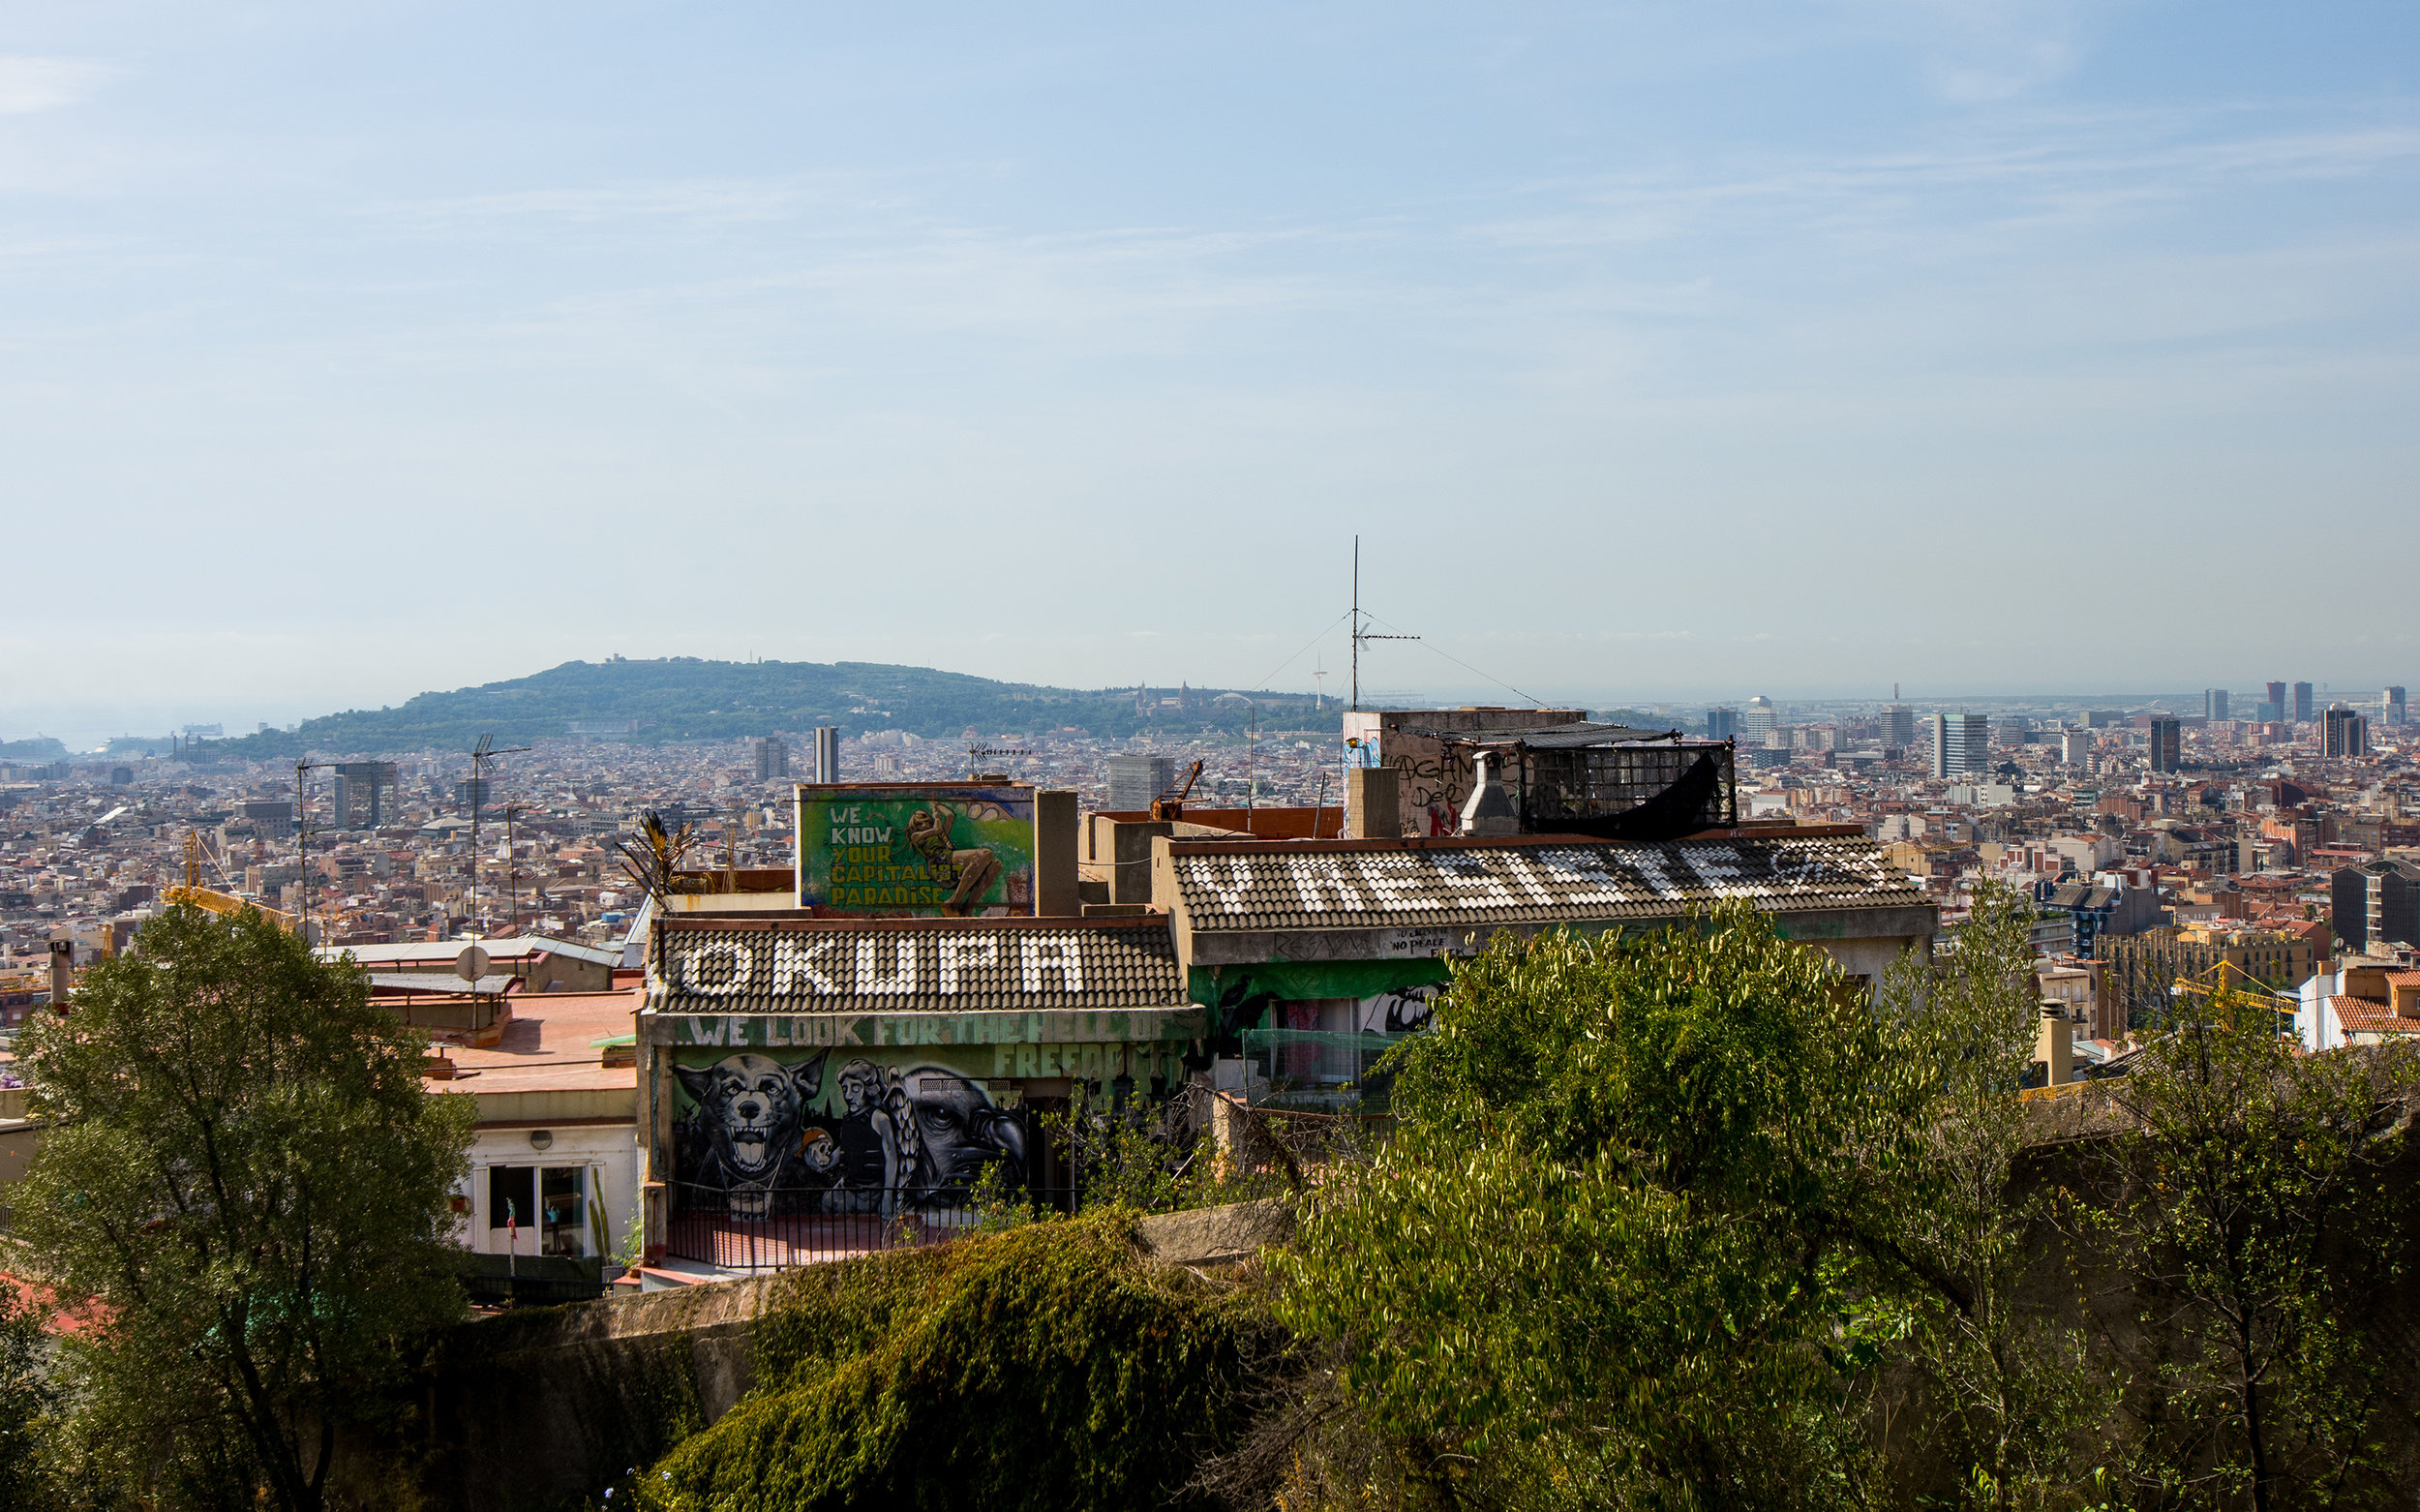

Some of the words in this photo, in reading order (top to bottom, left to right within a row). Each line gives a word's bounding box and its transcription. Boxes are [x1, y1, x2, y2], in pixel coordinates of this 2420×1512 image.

[830, 806, 861, 824] WE
[832, 827, 891, 844] KNOW
[832, 846, 891, 863] YOUR
[1393, 940, 1407, 952] NO
[682, 935, 1084, 996] OKUPA
[765, 1016, 864, 1046] LOOK
[874, 1015, 944, 1045] FOR
[947, 1013, 1021, 1044] THE
